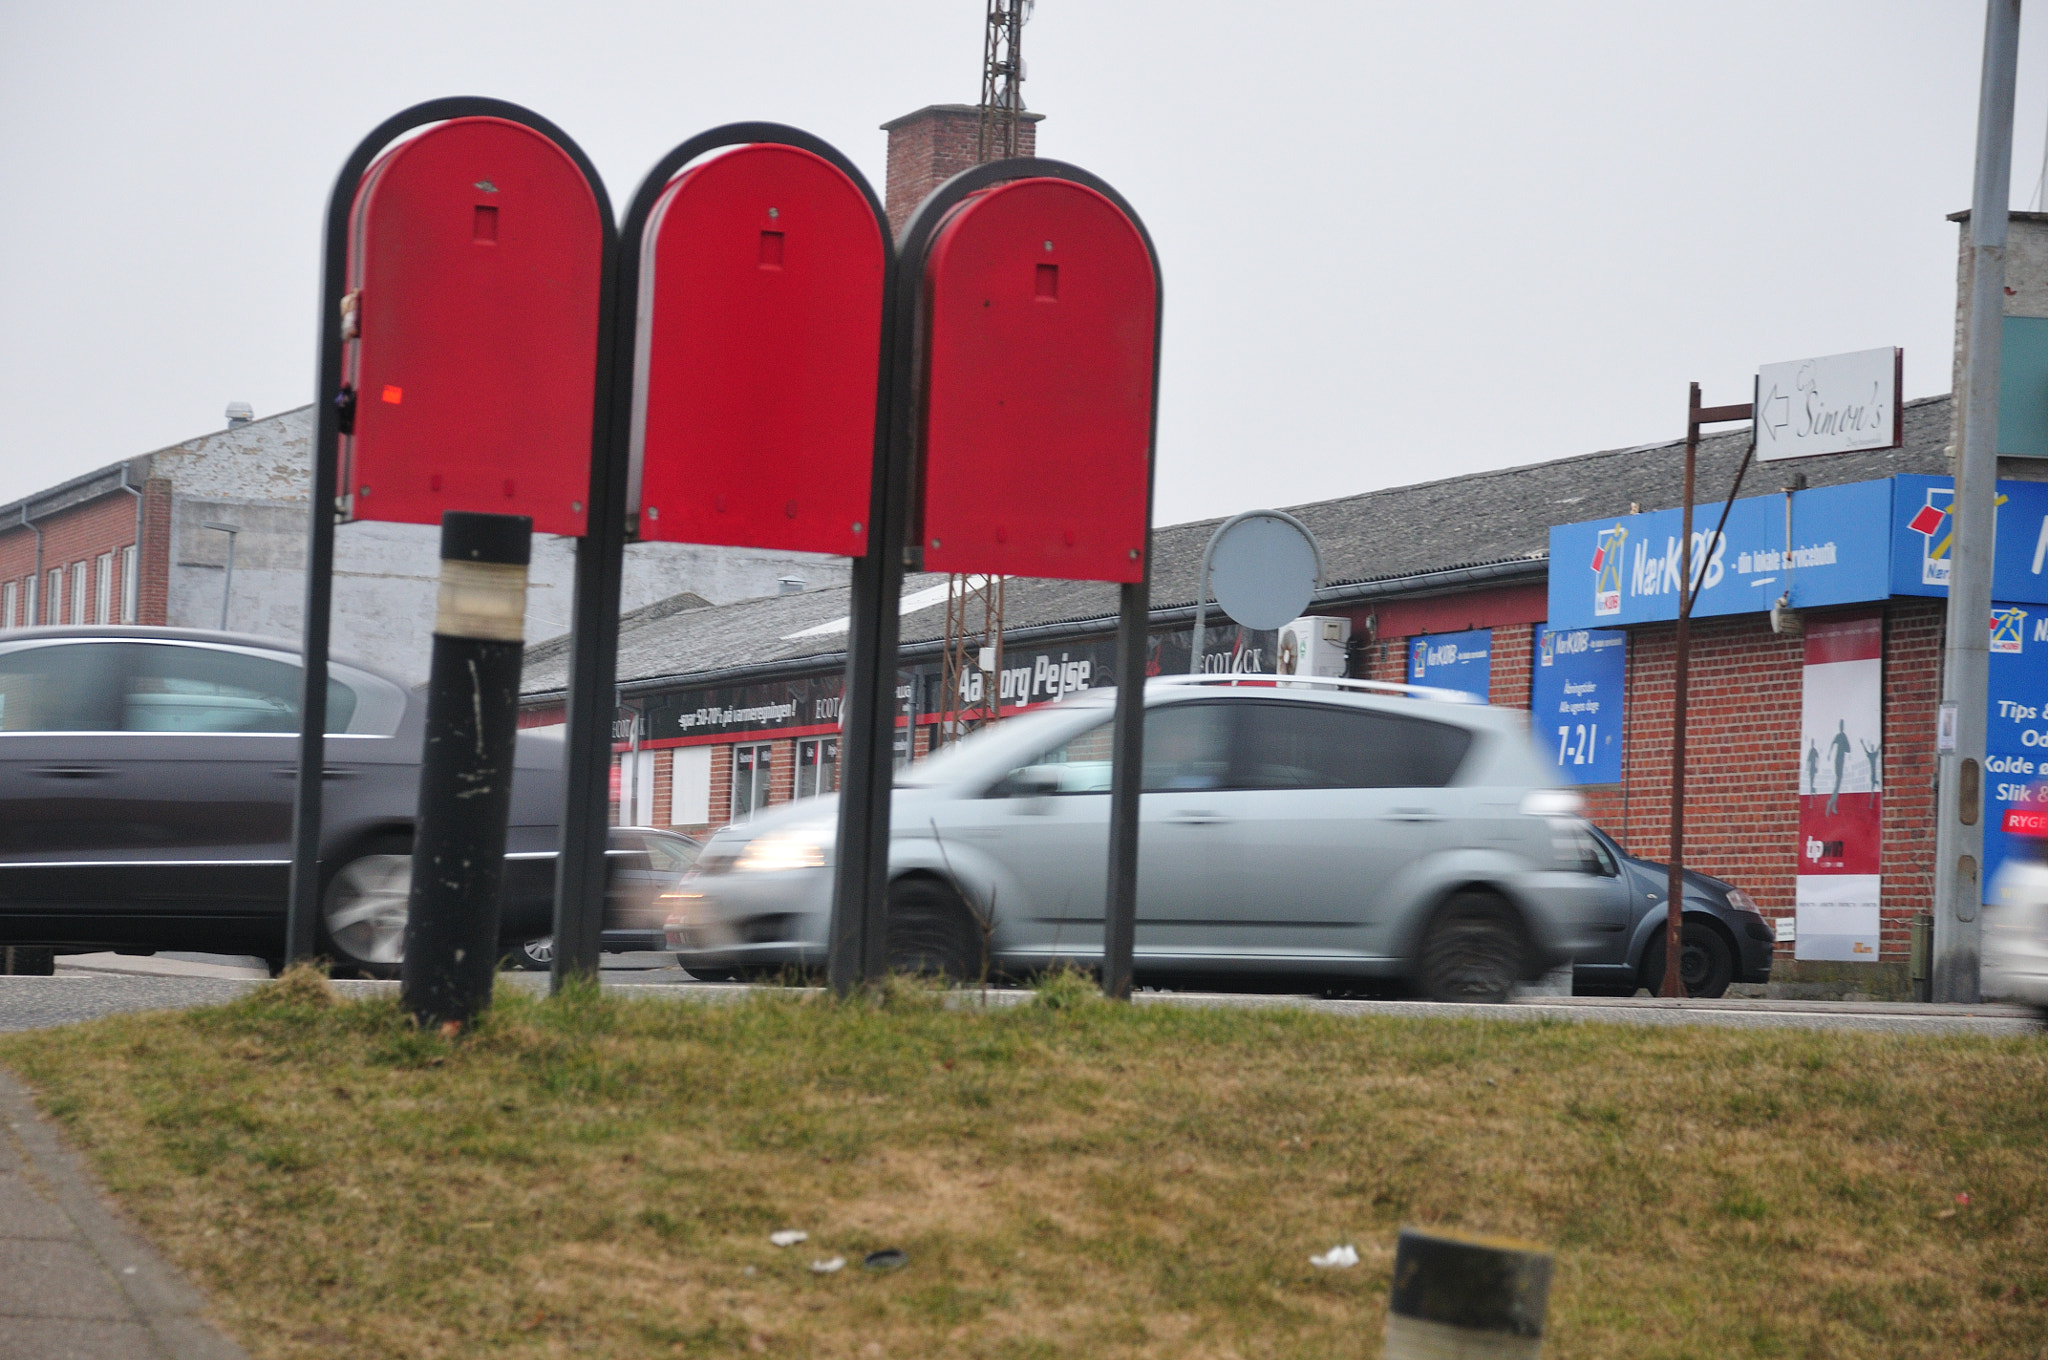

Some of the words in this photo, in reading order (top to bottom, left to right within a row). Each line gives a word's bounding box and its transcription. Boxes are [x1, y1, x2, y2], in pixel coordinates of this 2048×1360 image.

[1797, 381, 1883, 438] Simon's
[1631, 528, 1727, 597] NærKØB
[1927, 563, 1951, 580] Nær
[958, 665, 1032, 707] Aaorg
[1032, 653, 1091, 703] Pejse
[1997, 700, 2037, 723] Tips
[1996, 783, 2032, 802] Slik
